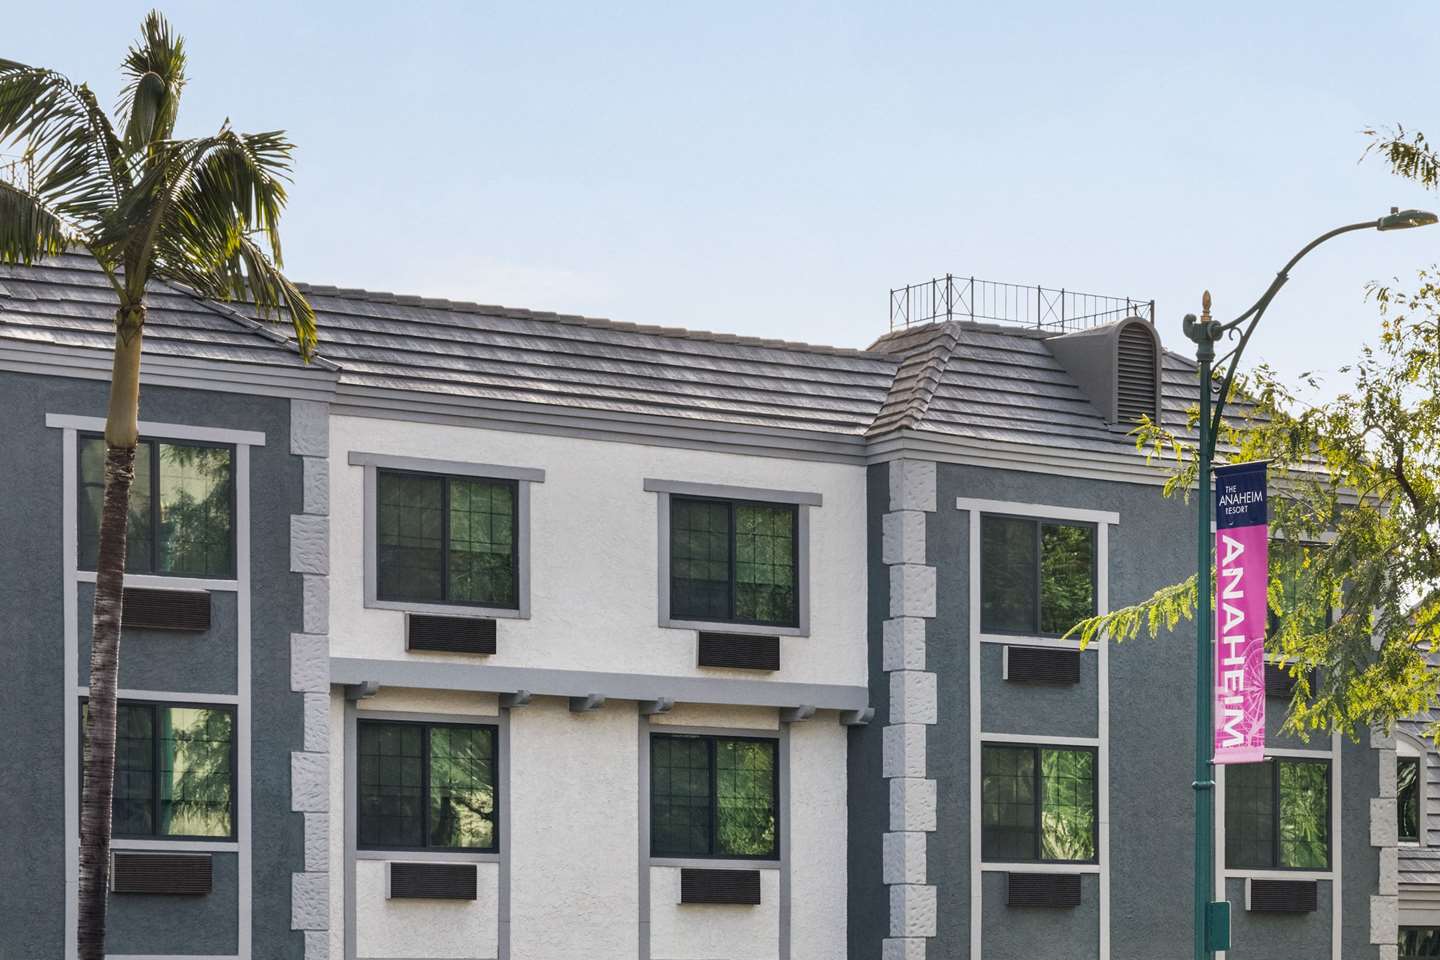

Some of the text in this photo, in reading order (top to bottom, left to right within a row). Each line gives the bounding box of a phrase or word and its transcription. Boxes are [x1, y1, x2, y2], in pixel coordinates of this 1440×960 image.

[1225, 485, 1237, 493] THE
[1219, 491, 1263, 506] ANAHEIM
[1225, 505, 1248, 515] RESORT
[1222, 535, 1245, 748] ANAHEIM
